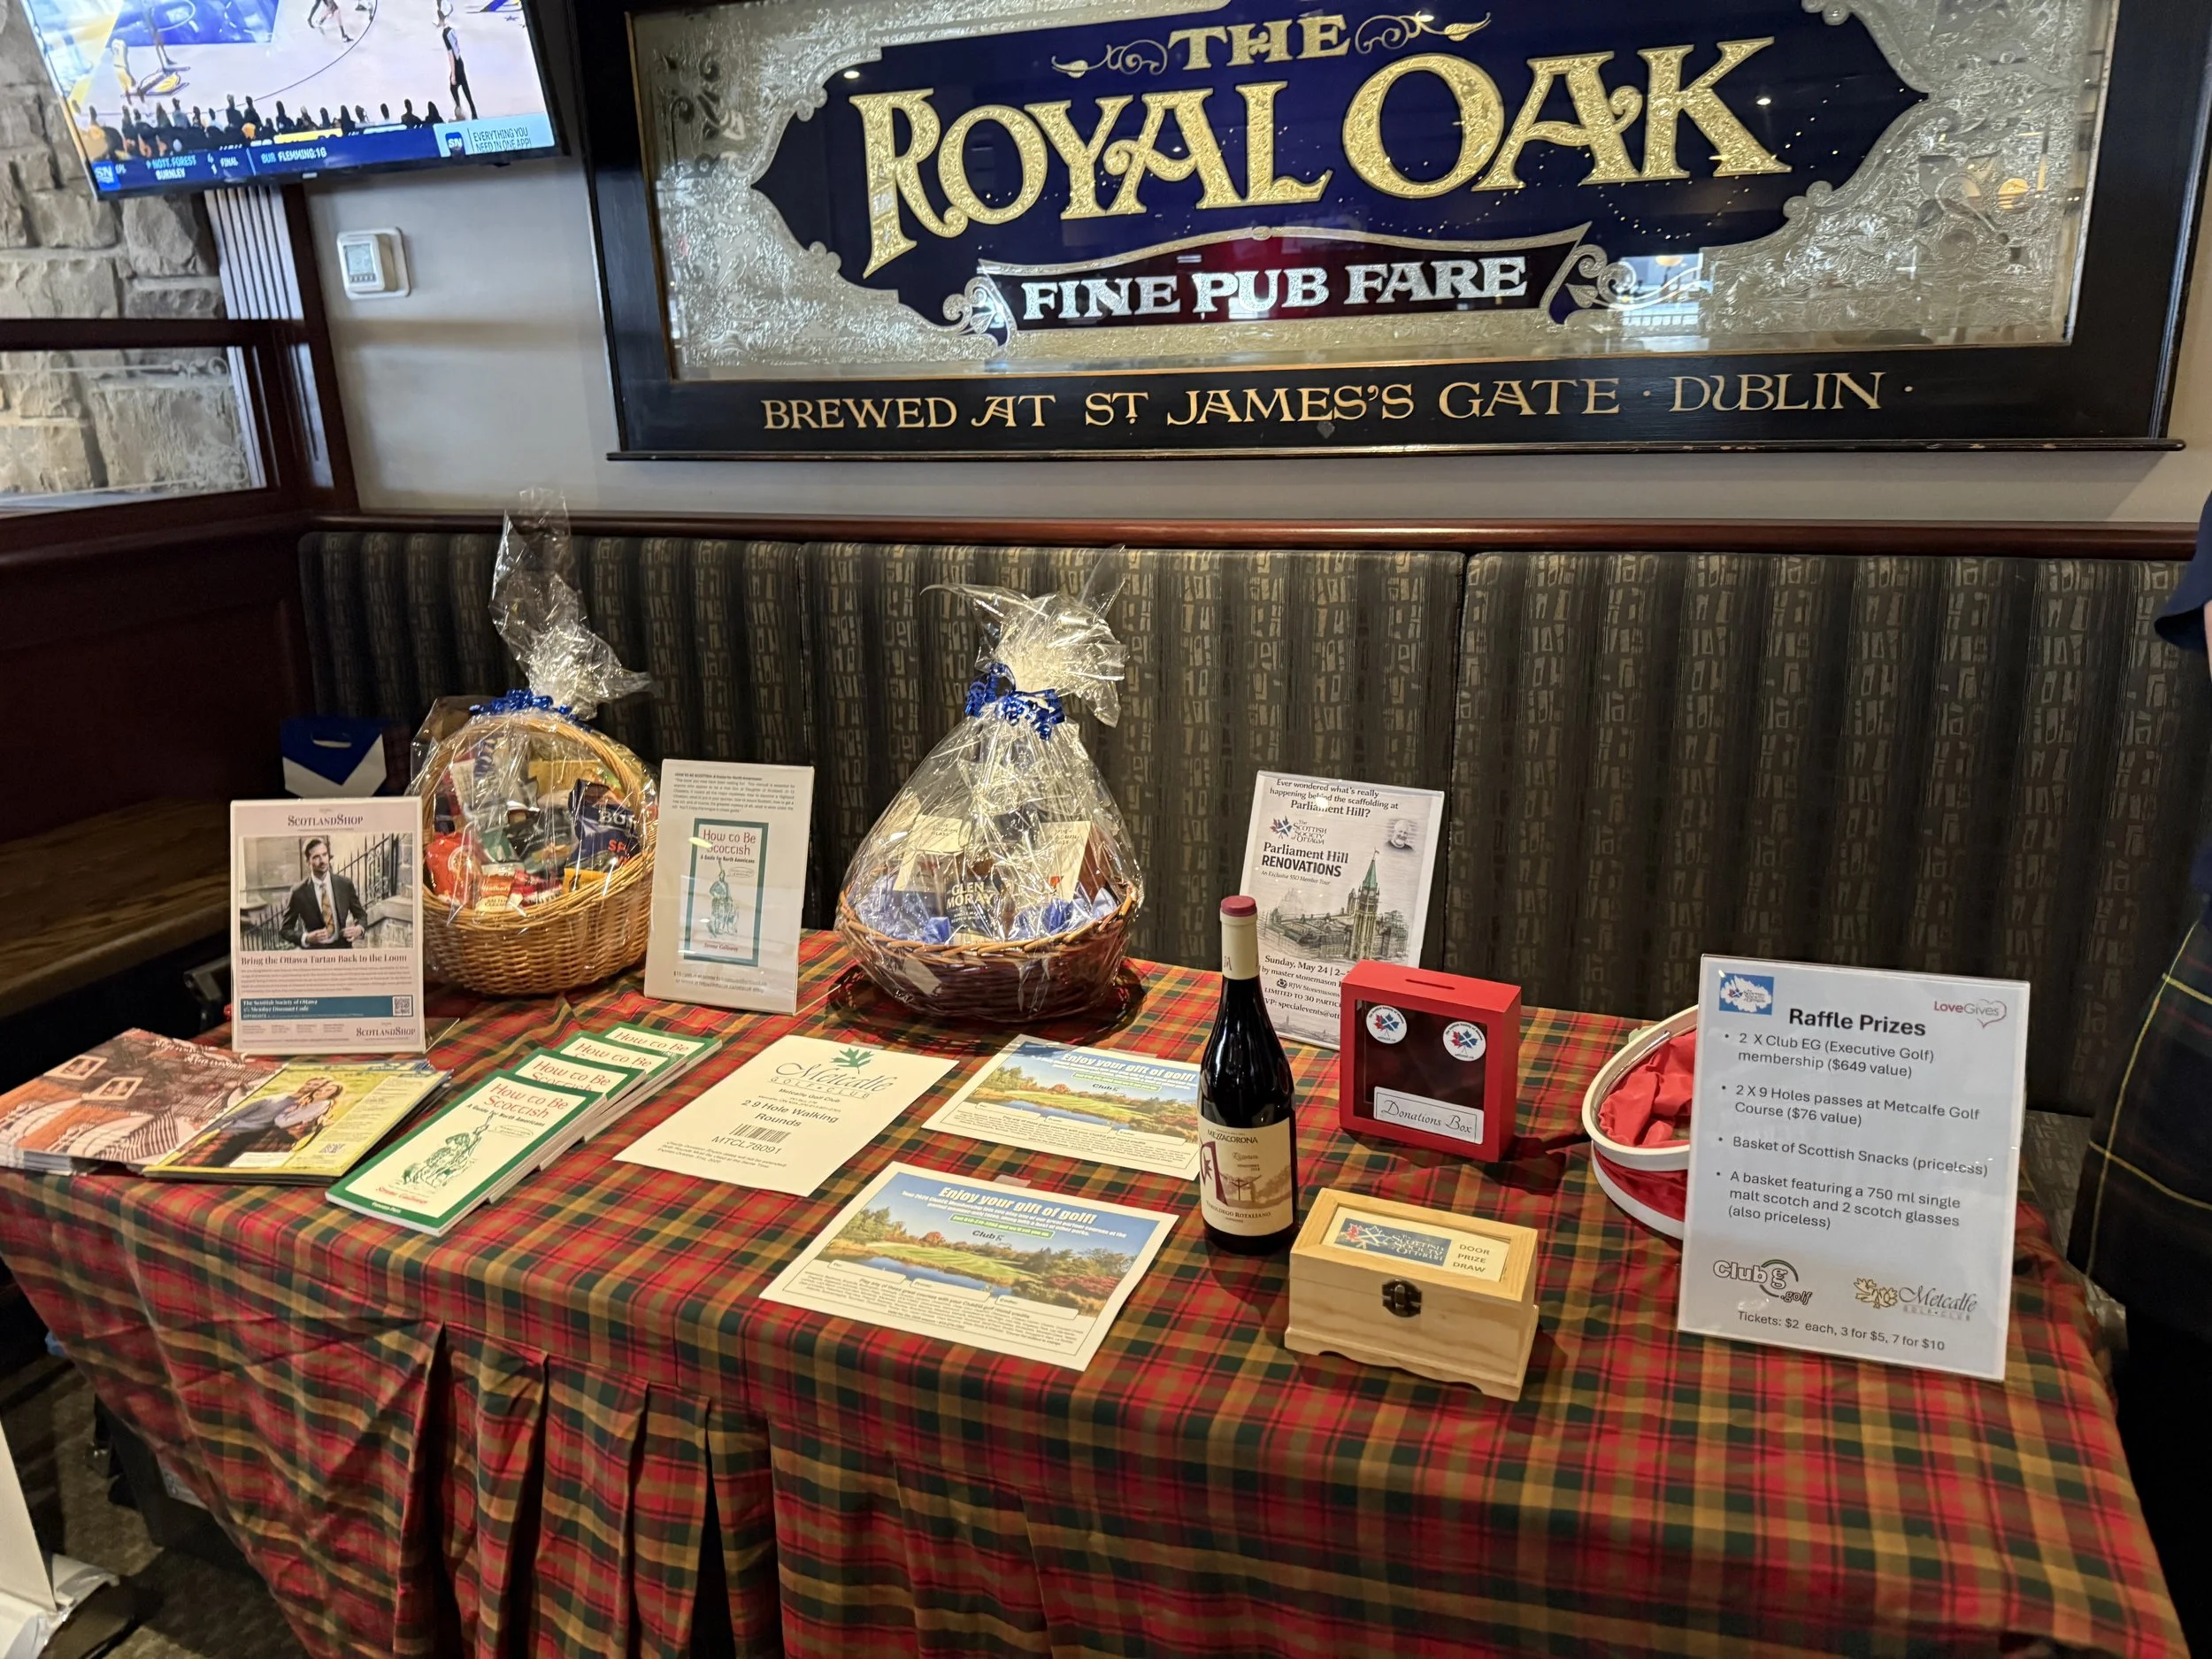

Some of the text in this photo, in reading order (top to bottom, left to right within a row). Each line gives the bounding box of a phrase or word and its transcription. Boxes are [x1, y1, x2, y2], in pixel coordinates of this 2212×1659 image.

[1168, 14, 1350, 70] THE
[473, 127, 528, 142] EVERYTHING YOU
[849, 36, 1793, 279] ROYAL OAK
[1021, 256, 1527, 319] FINE PUB FARE
[761, 396, 957, 430] BREWED
[972, 394, 1056, 428] AT
[1166, 382, 1415, 426] JAMES'S
[1439, 378, 1620, 420] GATE
[1668, 372, 1886, 411] DUBLIN
[1271, 787, 1306, 800] happening
[1348, 797, 1388, 810] scaffolding
[1294, 782, 1328, 791] wondered
[1331, 786, 1355, 795] what's
[1357, 790, 1379, 799] really
[1346, 806, 1371, 818] Hill?
[703, 829, 756, 843] How to Be
[1263, 842, 1348, 864] Parliament Hill
[1262, 856, 1341, 877] RENOVATIONS
[952, 882, 984, 895] GLEN
[947, 893, 993, 910] MORAY
[242, 956, 264, 966] Bring
[265, 956, 278, 964] the
[280, 956, 308, 964] Ottawa
[310, 955, 335, 964] Tartan
[338, 954, 357, 963] Back
[369, 954, 382, 963] the
[384, 954, 407, 963] Loom
[1264, 956, 1295, 968] Sunday,
[1298, 962, 1316, 972] May
[1296, 973, 1336, 987] stonemason
[1264, 987, 1292, 997] LIMITED
[1316, 998, 1340, 1007] PARTIC
[1934, 1001, 2000, 1017] LoveGives
[1789, 1008, 1925, 1036] Raffle Prizes
[614, 1032, 648, 1044] How
[669, 1042, 689, 1052] Be
[1740, 1033, 1934, 1064] 2 X Club EG (Executive Golf)
[575, 1042, 652, 1067] How to Be
[1063, 1053, 1096, 1065] Enjoy
[1096, 1060, 1126, 1070] your
[1126, 1064, 1148, 1073] gift
[1739, 1052, 1912, 1079] membership ($649 value)
[534, 1060, 611, 1087] How to Be
[775, 1063, 898, 1092] Metcalfe
[484, 1096, 549, 1118] Scottish
[490, 1083, 526, 1100] How
[548, 1097, 569, 1110] Be
[1736, 1085, 1980, 1119] 2 X 9 Holes passes at Metcalfe Golf
[755, 1113, 803, 1127] Rounds
[762, 1102, 789, 1113] Hole
[792, 1109, 839, 1124] Walking
[1381, 1099, 1472, 1133] Donations Box
[1735, 1102, 1862, 1127] Course ($76 value)
[1733, 1136, 1988, 1178] Basket of Scottish Snacks (priceless)
[1730, 1171, 1961, 1210] A basket featuring a 750 ml single
[939, 1187, 1097, 1224] Enjoy your gift of golf!
[1730, 1190, 1960, 1226] malt scotch and 2 scotch glasses
[1728, 1205, 1831, 1230] (also priceless)
[1457, 1253, 1486, 1263] PRIZE
[1459, 1244, 1490, 1256] DOOR
[1452, 1262, 1486, 1272] DRAW
[1899, 1285, 1978, 1313] Metcalfe
[1738, 1310, 1945, 1351] Tickets: $2 each, 3 for $5, 7 for $10
